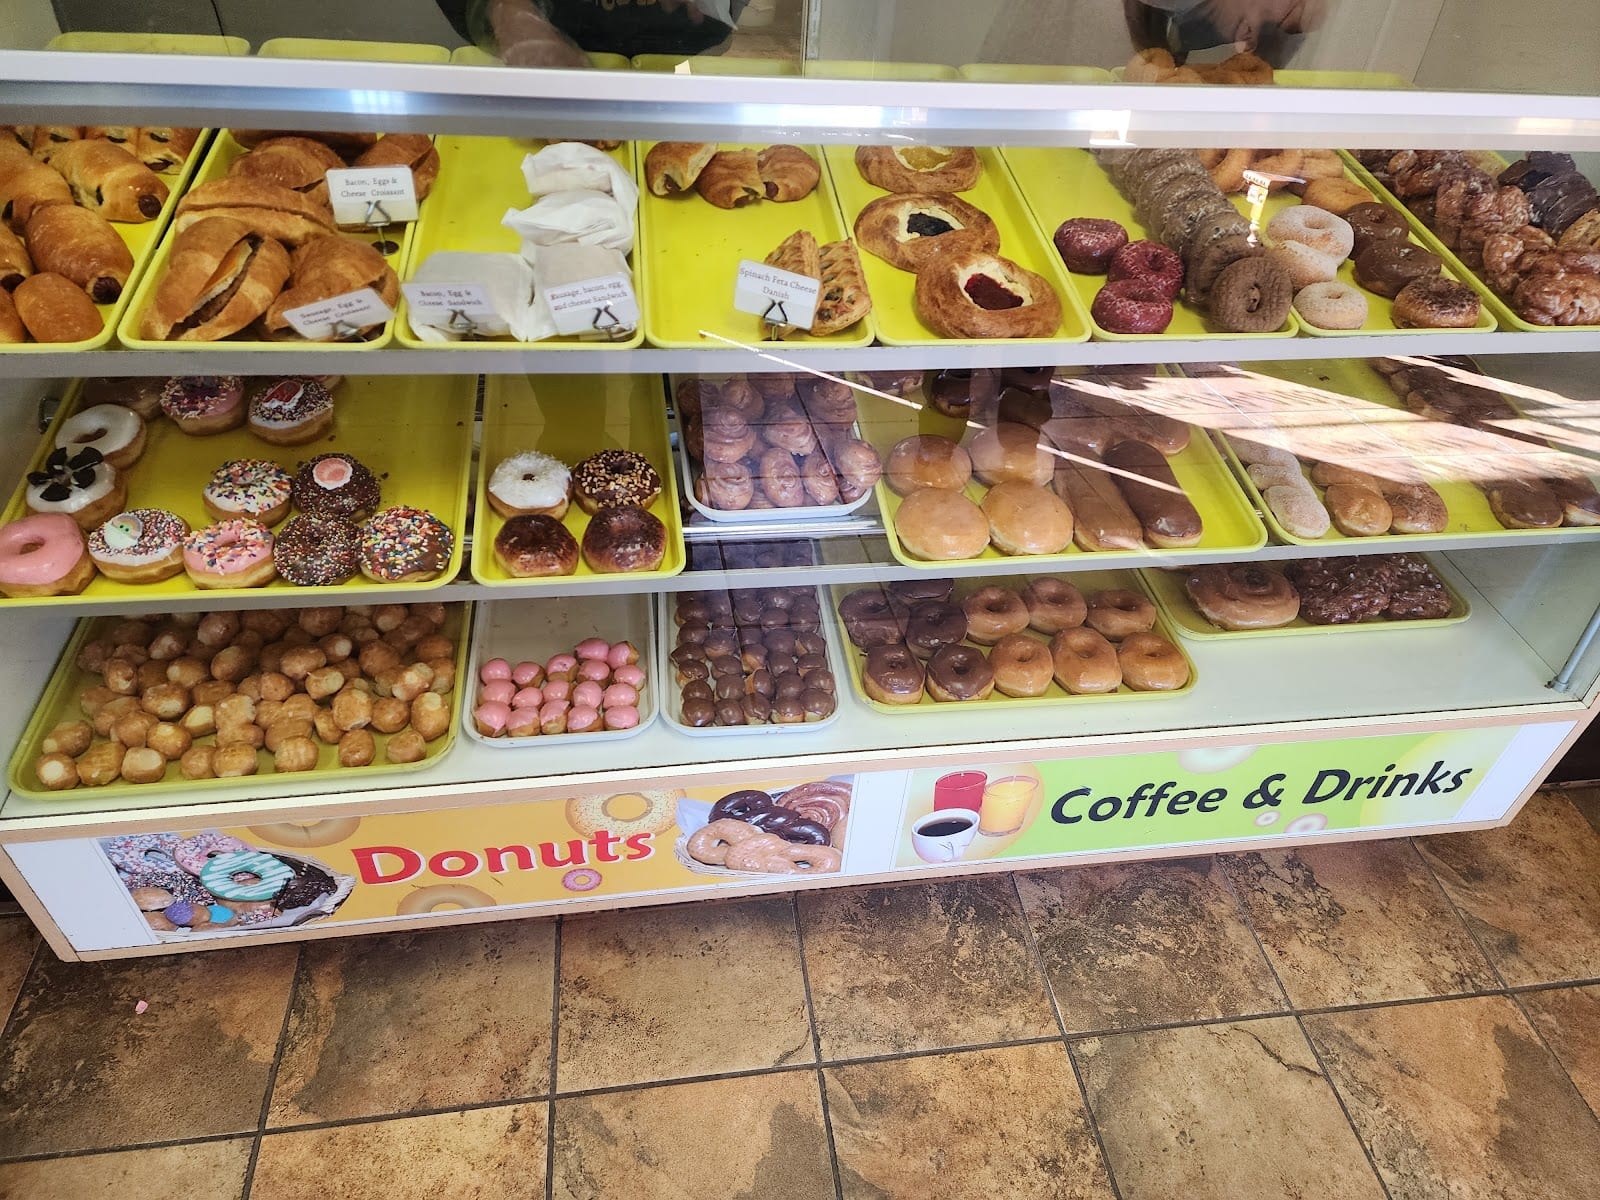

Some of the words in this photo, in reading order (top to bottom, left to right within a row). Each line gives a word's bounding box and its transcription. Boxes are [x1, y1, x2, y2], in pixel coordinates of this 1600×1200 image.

[345, 178, 370, 187] Bacon,
[373, 177, 389, 186] Eggs
[740, 268, 771, 283] Spinach
[772, 275, 789, 287] Feta
[790, 281, 817, 295] Cheese
[763, 286, 790, 301] Danish
[1051, 781, 1229, 824] Coffee
[1243, 773, 1287, 810] &
[1302, 761, 1473, 805] Drinks
[351, 830, 656, 886] Donuts
